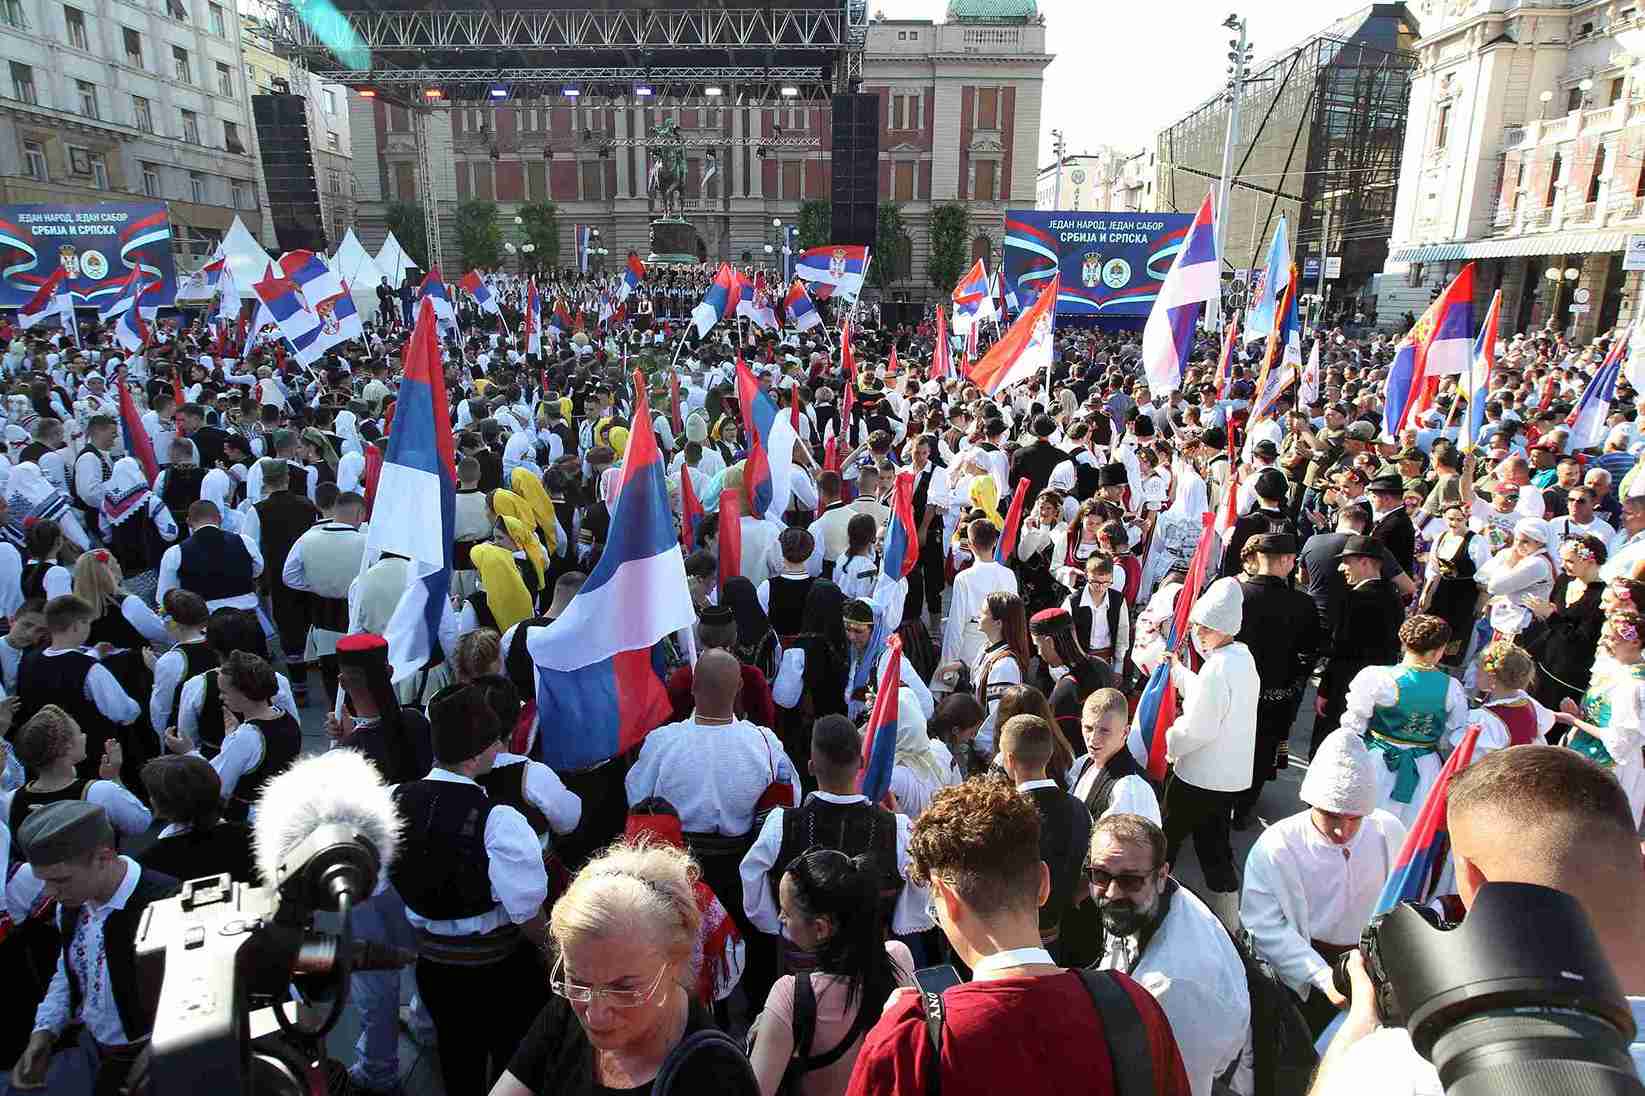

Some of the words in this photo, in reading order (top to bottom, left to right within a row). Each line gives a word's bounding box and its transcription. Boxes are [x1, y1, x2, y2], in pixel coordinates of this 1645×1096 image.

[32, 225, 67, 235] СРБИЈА
[69, 225, 78, 236] И
[79, 225, 117, 235] СРПСКА
[1048, 219, 1075, 230] ЈЕДАН
[1110, 220, 1135, 231] ЈЕДАН
[1136, 221, 1164, 231] САБОР
[1060, 232, 1097, 242] СРБИЈА
[1099, 232, 1107, 243] И
[1109, 233, 1148, 243] СРПСКА
[927, 992, 941, 1020] ONY
